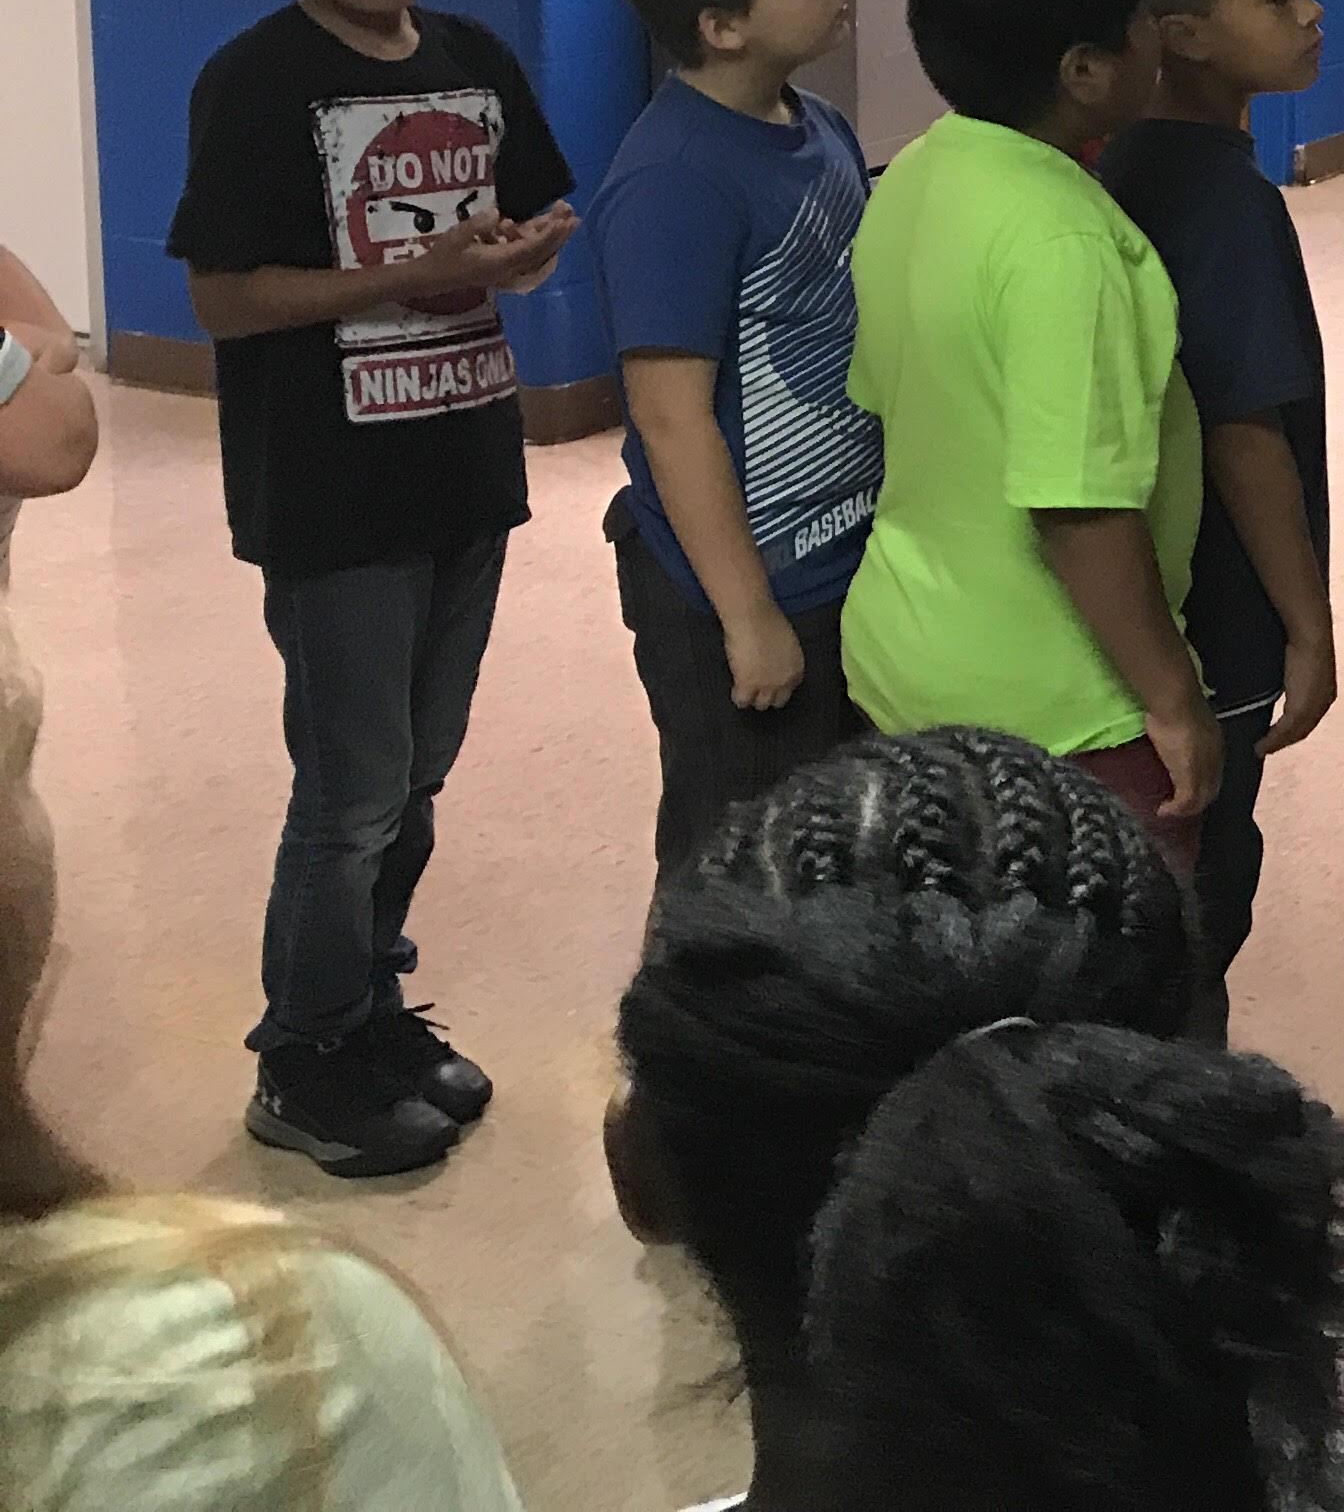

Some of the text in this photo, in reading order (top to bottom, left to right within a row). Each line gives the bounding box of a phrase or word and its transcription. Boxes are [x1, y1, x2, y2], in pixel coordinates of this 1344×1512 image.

[368, 144, 491, 191] DO NOT
[359, 357, 471, 406] NINJAS
[794, 486, 876, 560] BASEBAL
